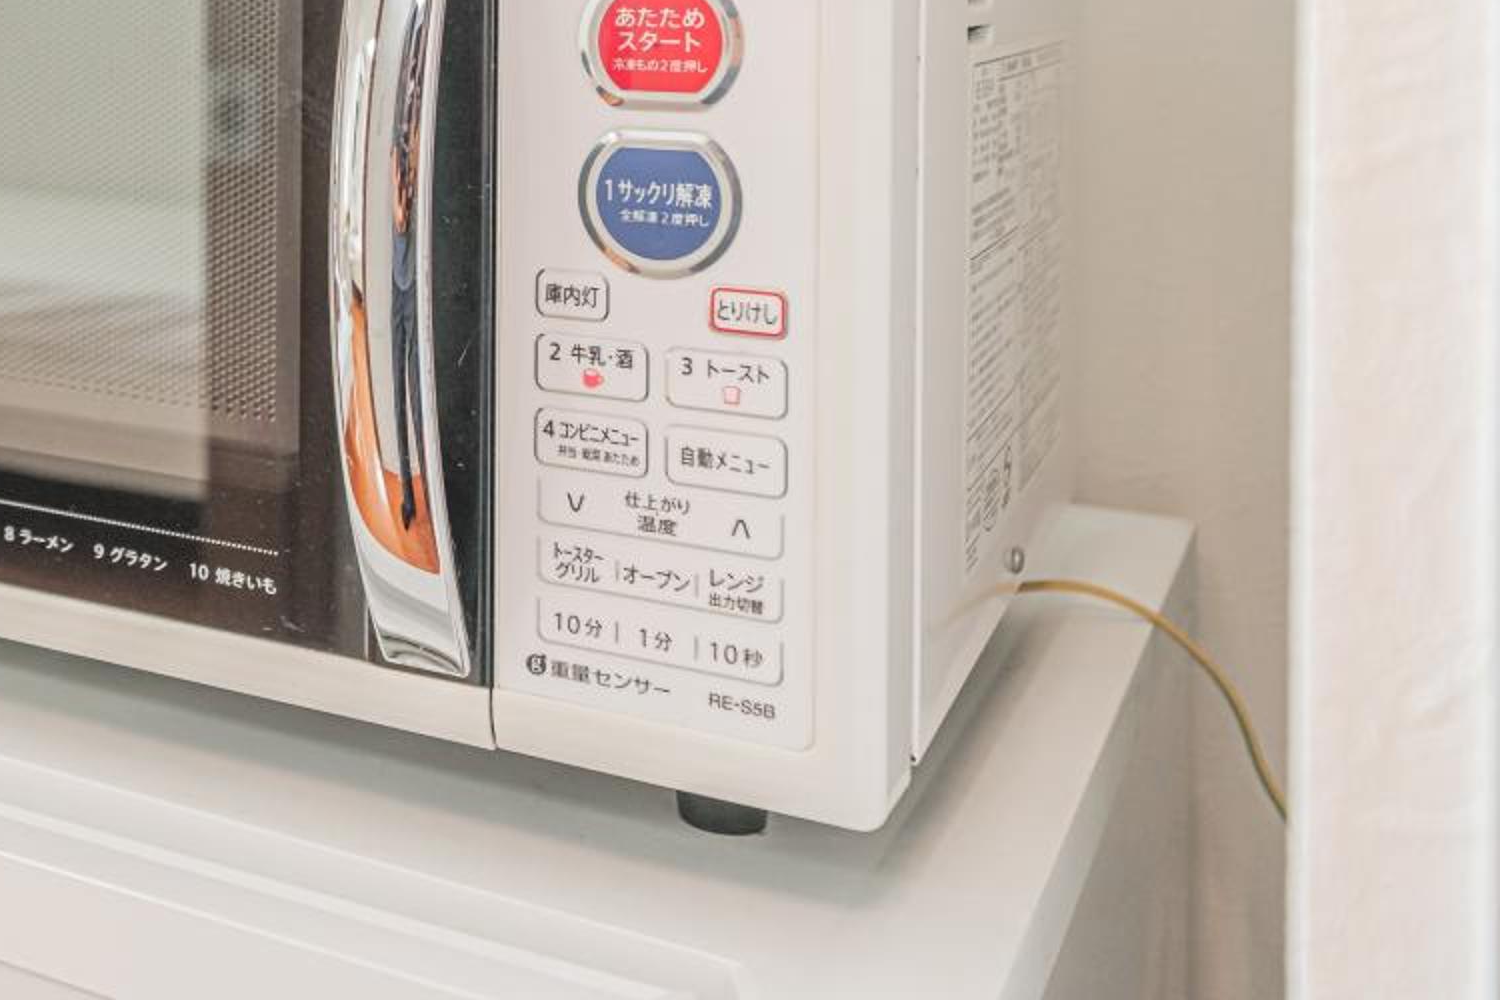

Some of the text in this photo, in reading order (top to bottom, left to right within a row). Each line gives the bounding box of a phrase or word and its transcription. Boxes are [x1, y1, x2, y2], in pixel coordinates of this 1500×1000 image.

[614, 7, 706, 30] あたため
[617, 31, 701, 53] スタート
[545, 283, 601, 309] 庫内灯
[716, 300, 777, 326] とりけし
[550, 342, 633, 370] 2 牛乳・酒
[681, 357, 770, 383] 3 トースト
[543, 420, 639, 446] 4 コンビニメニュー
[680, 446, 771, 475] 自動メニュー
[624, 490, 691, 515] 仕上がり
[637, 514, 677, 537] 温度
[4, 525, 75, 553] 8 ラーメン
[93, 543, 169, 572] 9 グラタン
[553, 541, 605, 564] トースター
[190, 563, 278, 595] 10 焼きいも
[554, 560, 600, 584] グリル
[623, 563, 691, 593] オープン
[708, 568, 764, 593] レンジ
[708, 593, 764, 616] 出力切替
[554, 611, 603, 638] 10分
[639, 627, 673, 651] 1分
[710, 641, 764, 668] 10秒
[550, 659, 670, 695] 重量センサー
[708, 692, 776, 720] RE-S5B
